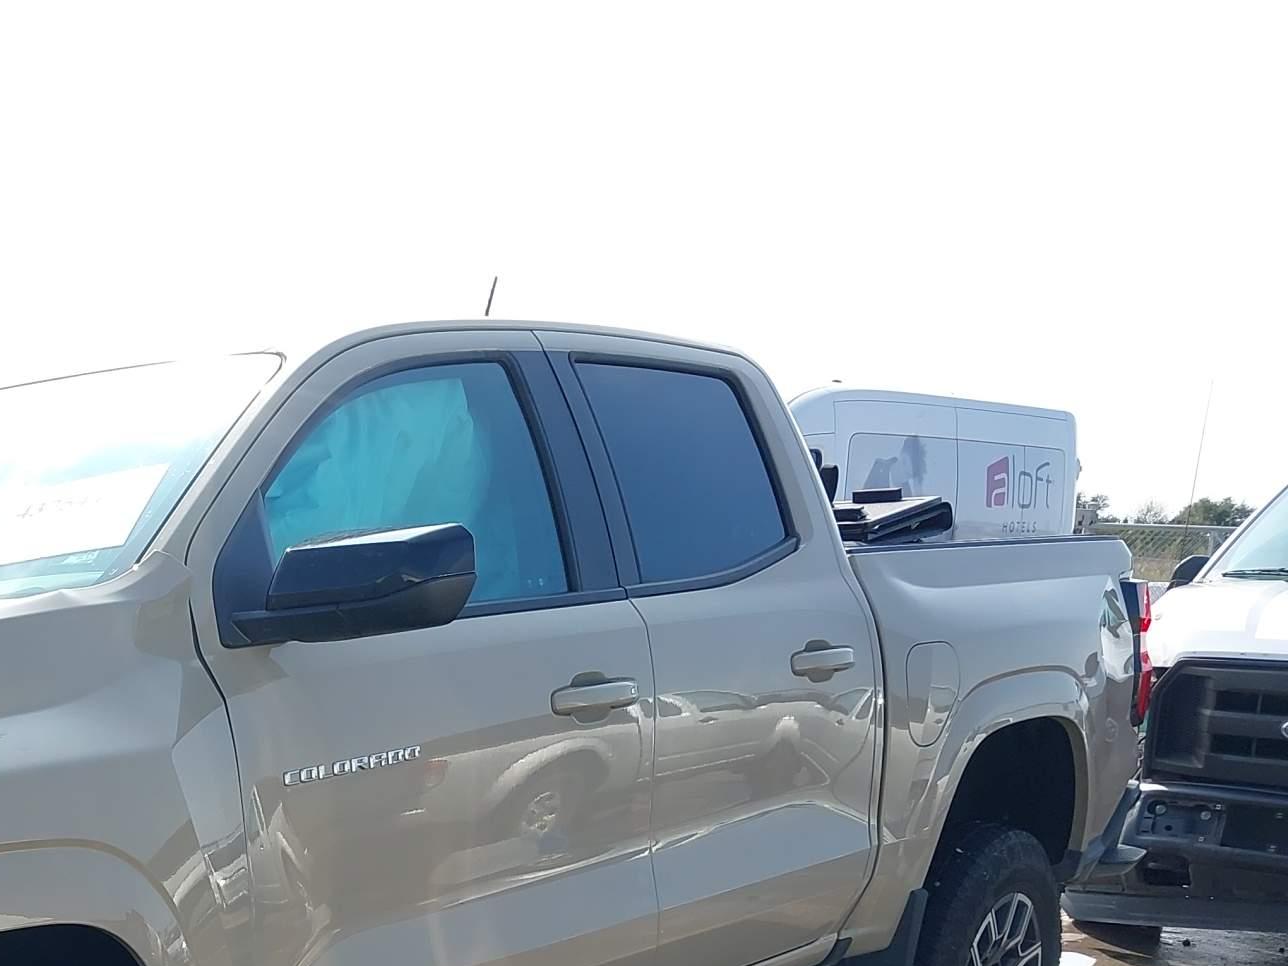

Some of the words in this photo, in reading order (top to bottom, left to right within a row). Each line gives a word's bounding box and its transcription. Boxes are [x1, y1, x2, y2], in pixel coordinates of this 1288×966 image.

[985, 454, 1053, 510] aloft
[1001, 520, 1038, 535] HOTELS
[282, 745, 421, 787] COLORADO
